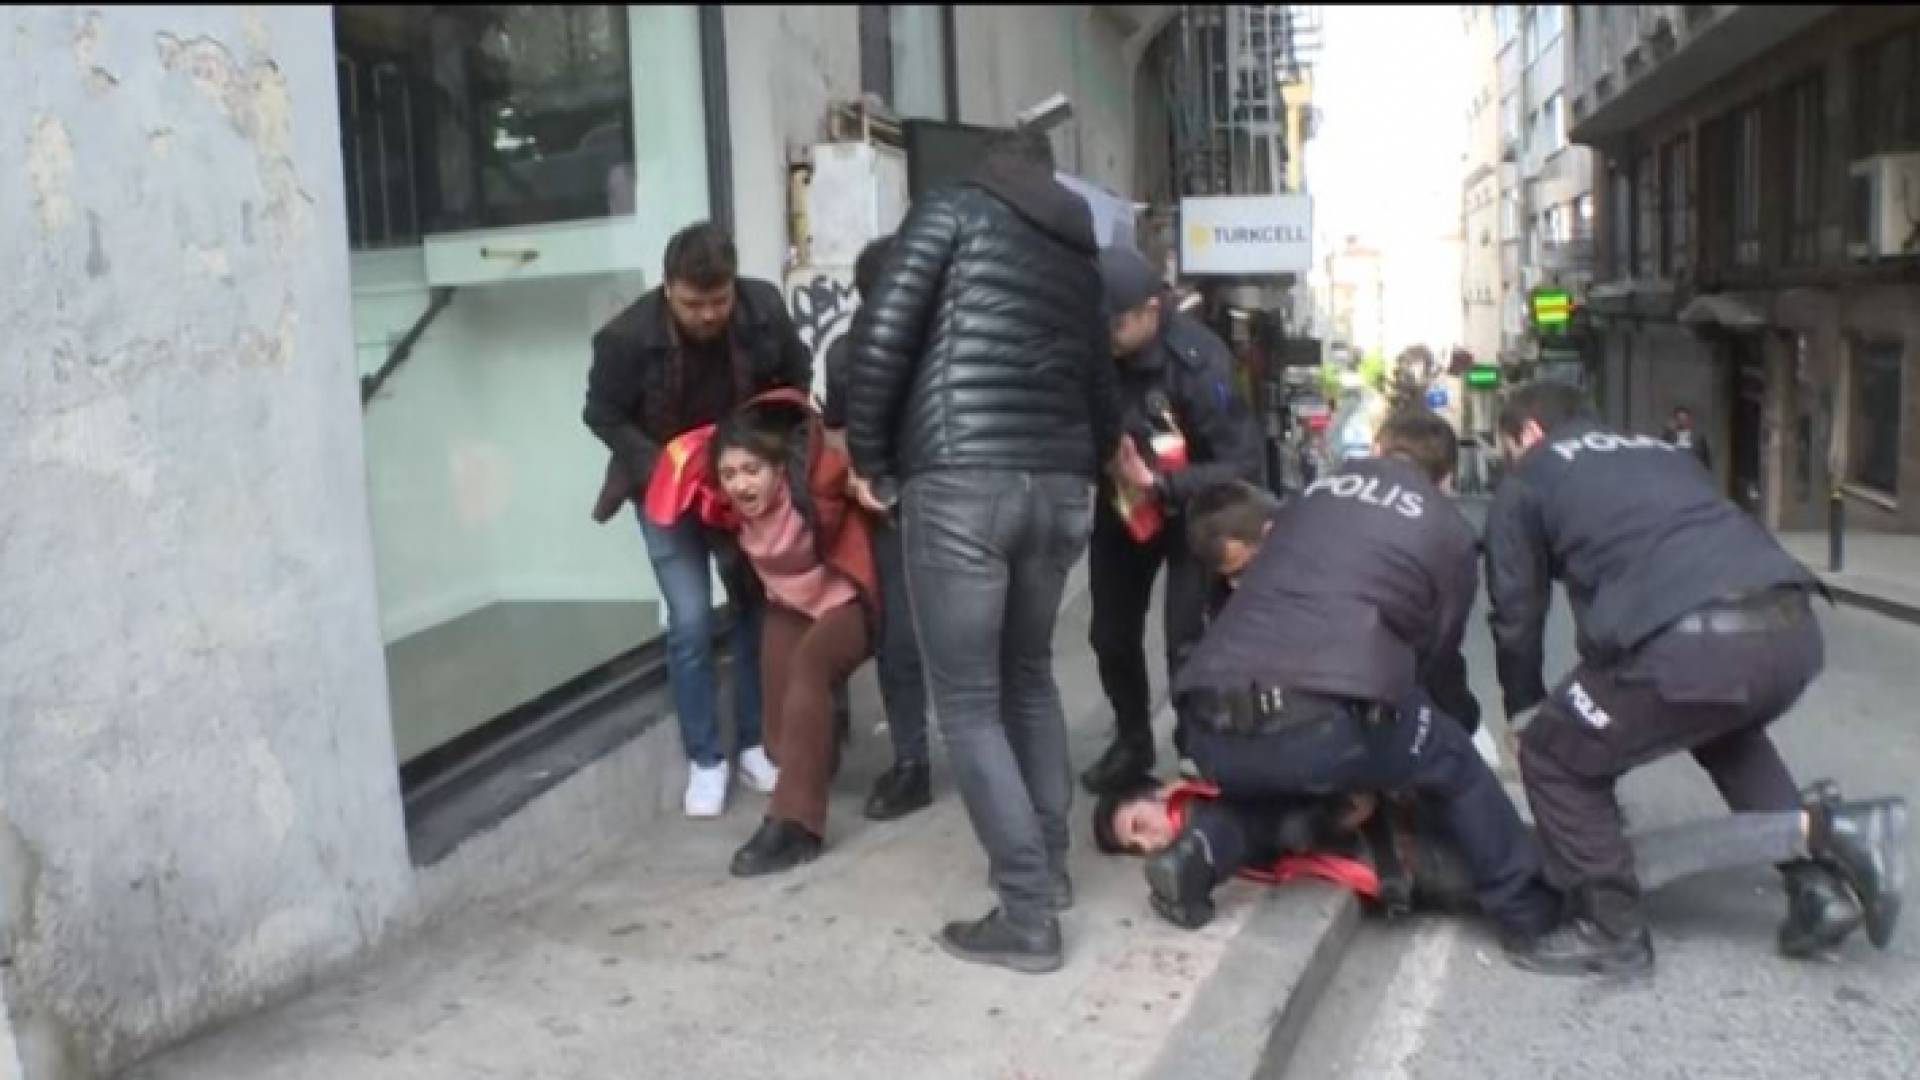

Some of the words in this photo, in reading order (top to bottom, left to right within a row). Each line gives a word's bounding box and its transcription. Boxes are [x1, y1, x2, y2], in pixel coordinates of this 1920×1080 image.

[1213, 223, 1309, 244] TURKCELL
[1303, 474, 1424, 518] POLIS
[1568, 681, 1611, 729] POLIS
